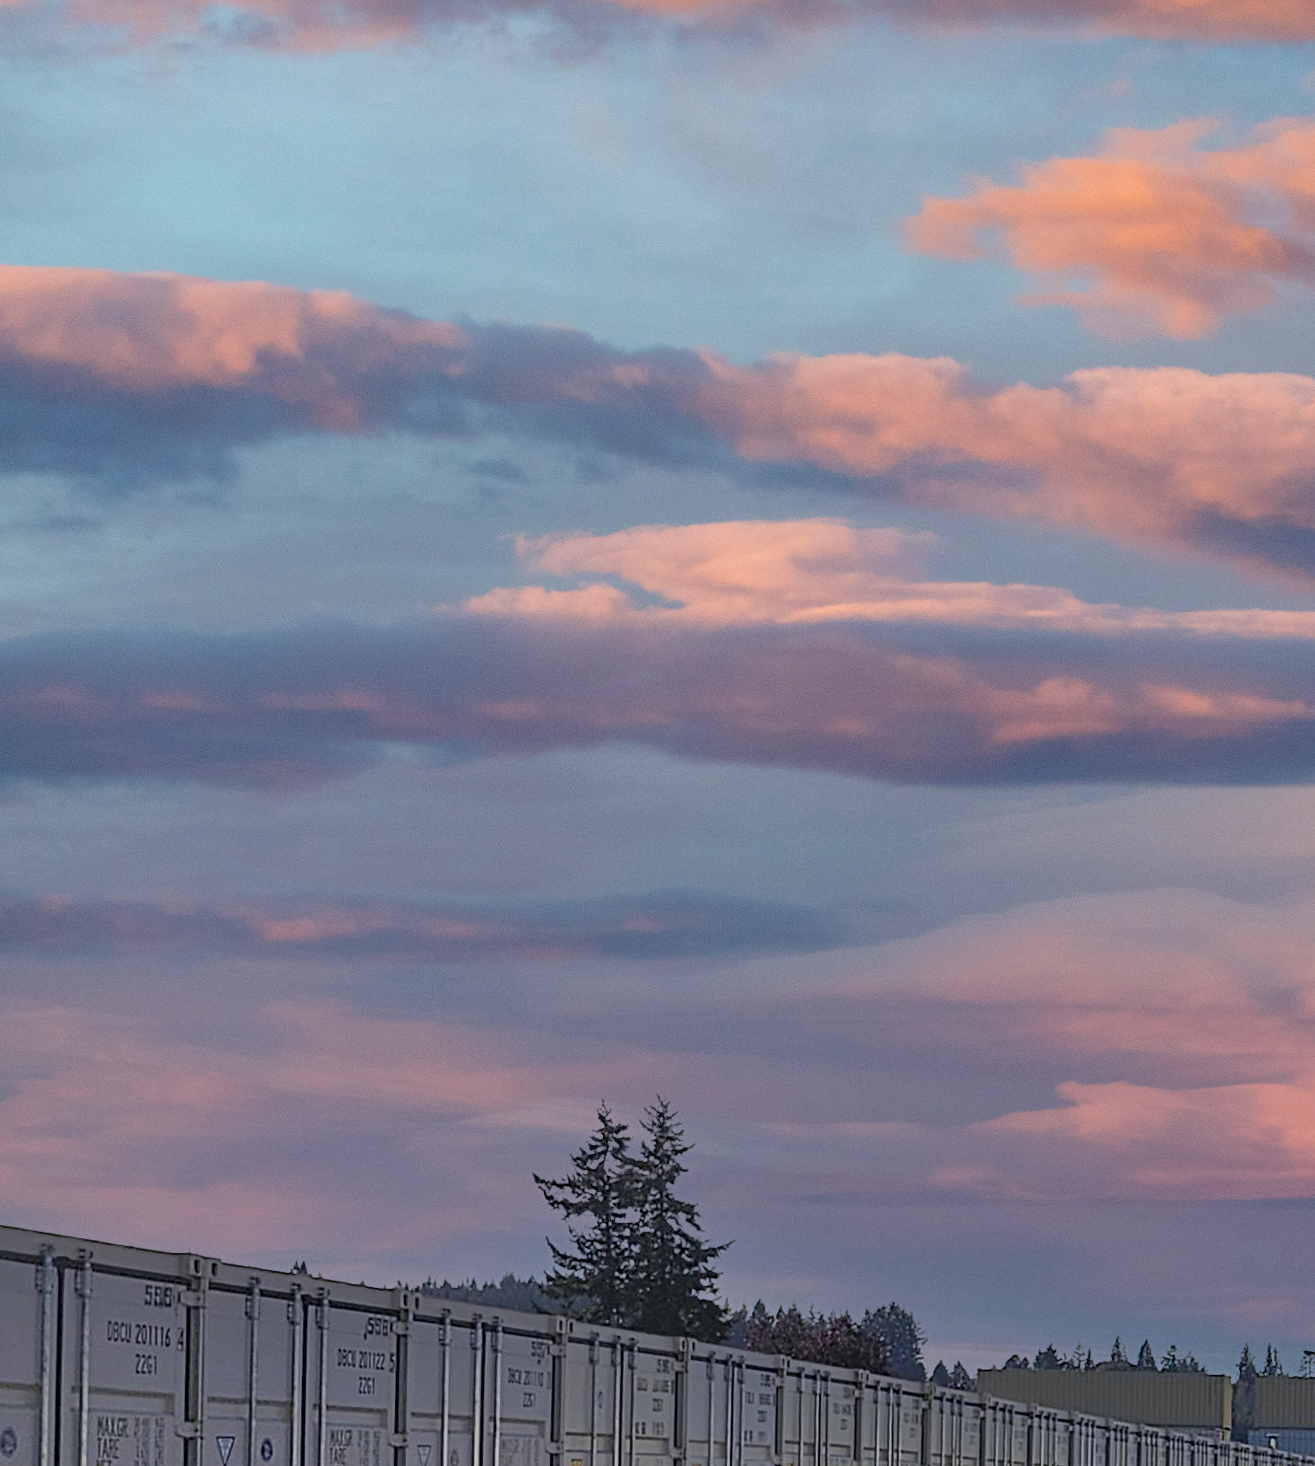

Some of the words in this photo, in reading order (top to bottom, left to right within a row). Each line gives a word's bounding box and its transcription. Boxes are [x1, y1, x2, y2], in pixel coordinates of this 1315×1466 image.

[107, 1319, 132, 1344] DBCU
[135, 1323, 171, 1348] 201116
[134, 1353, 158, 1376] 22G1
